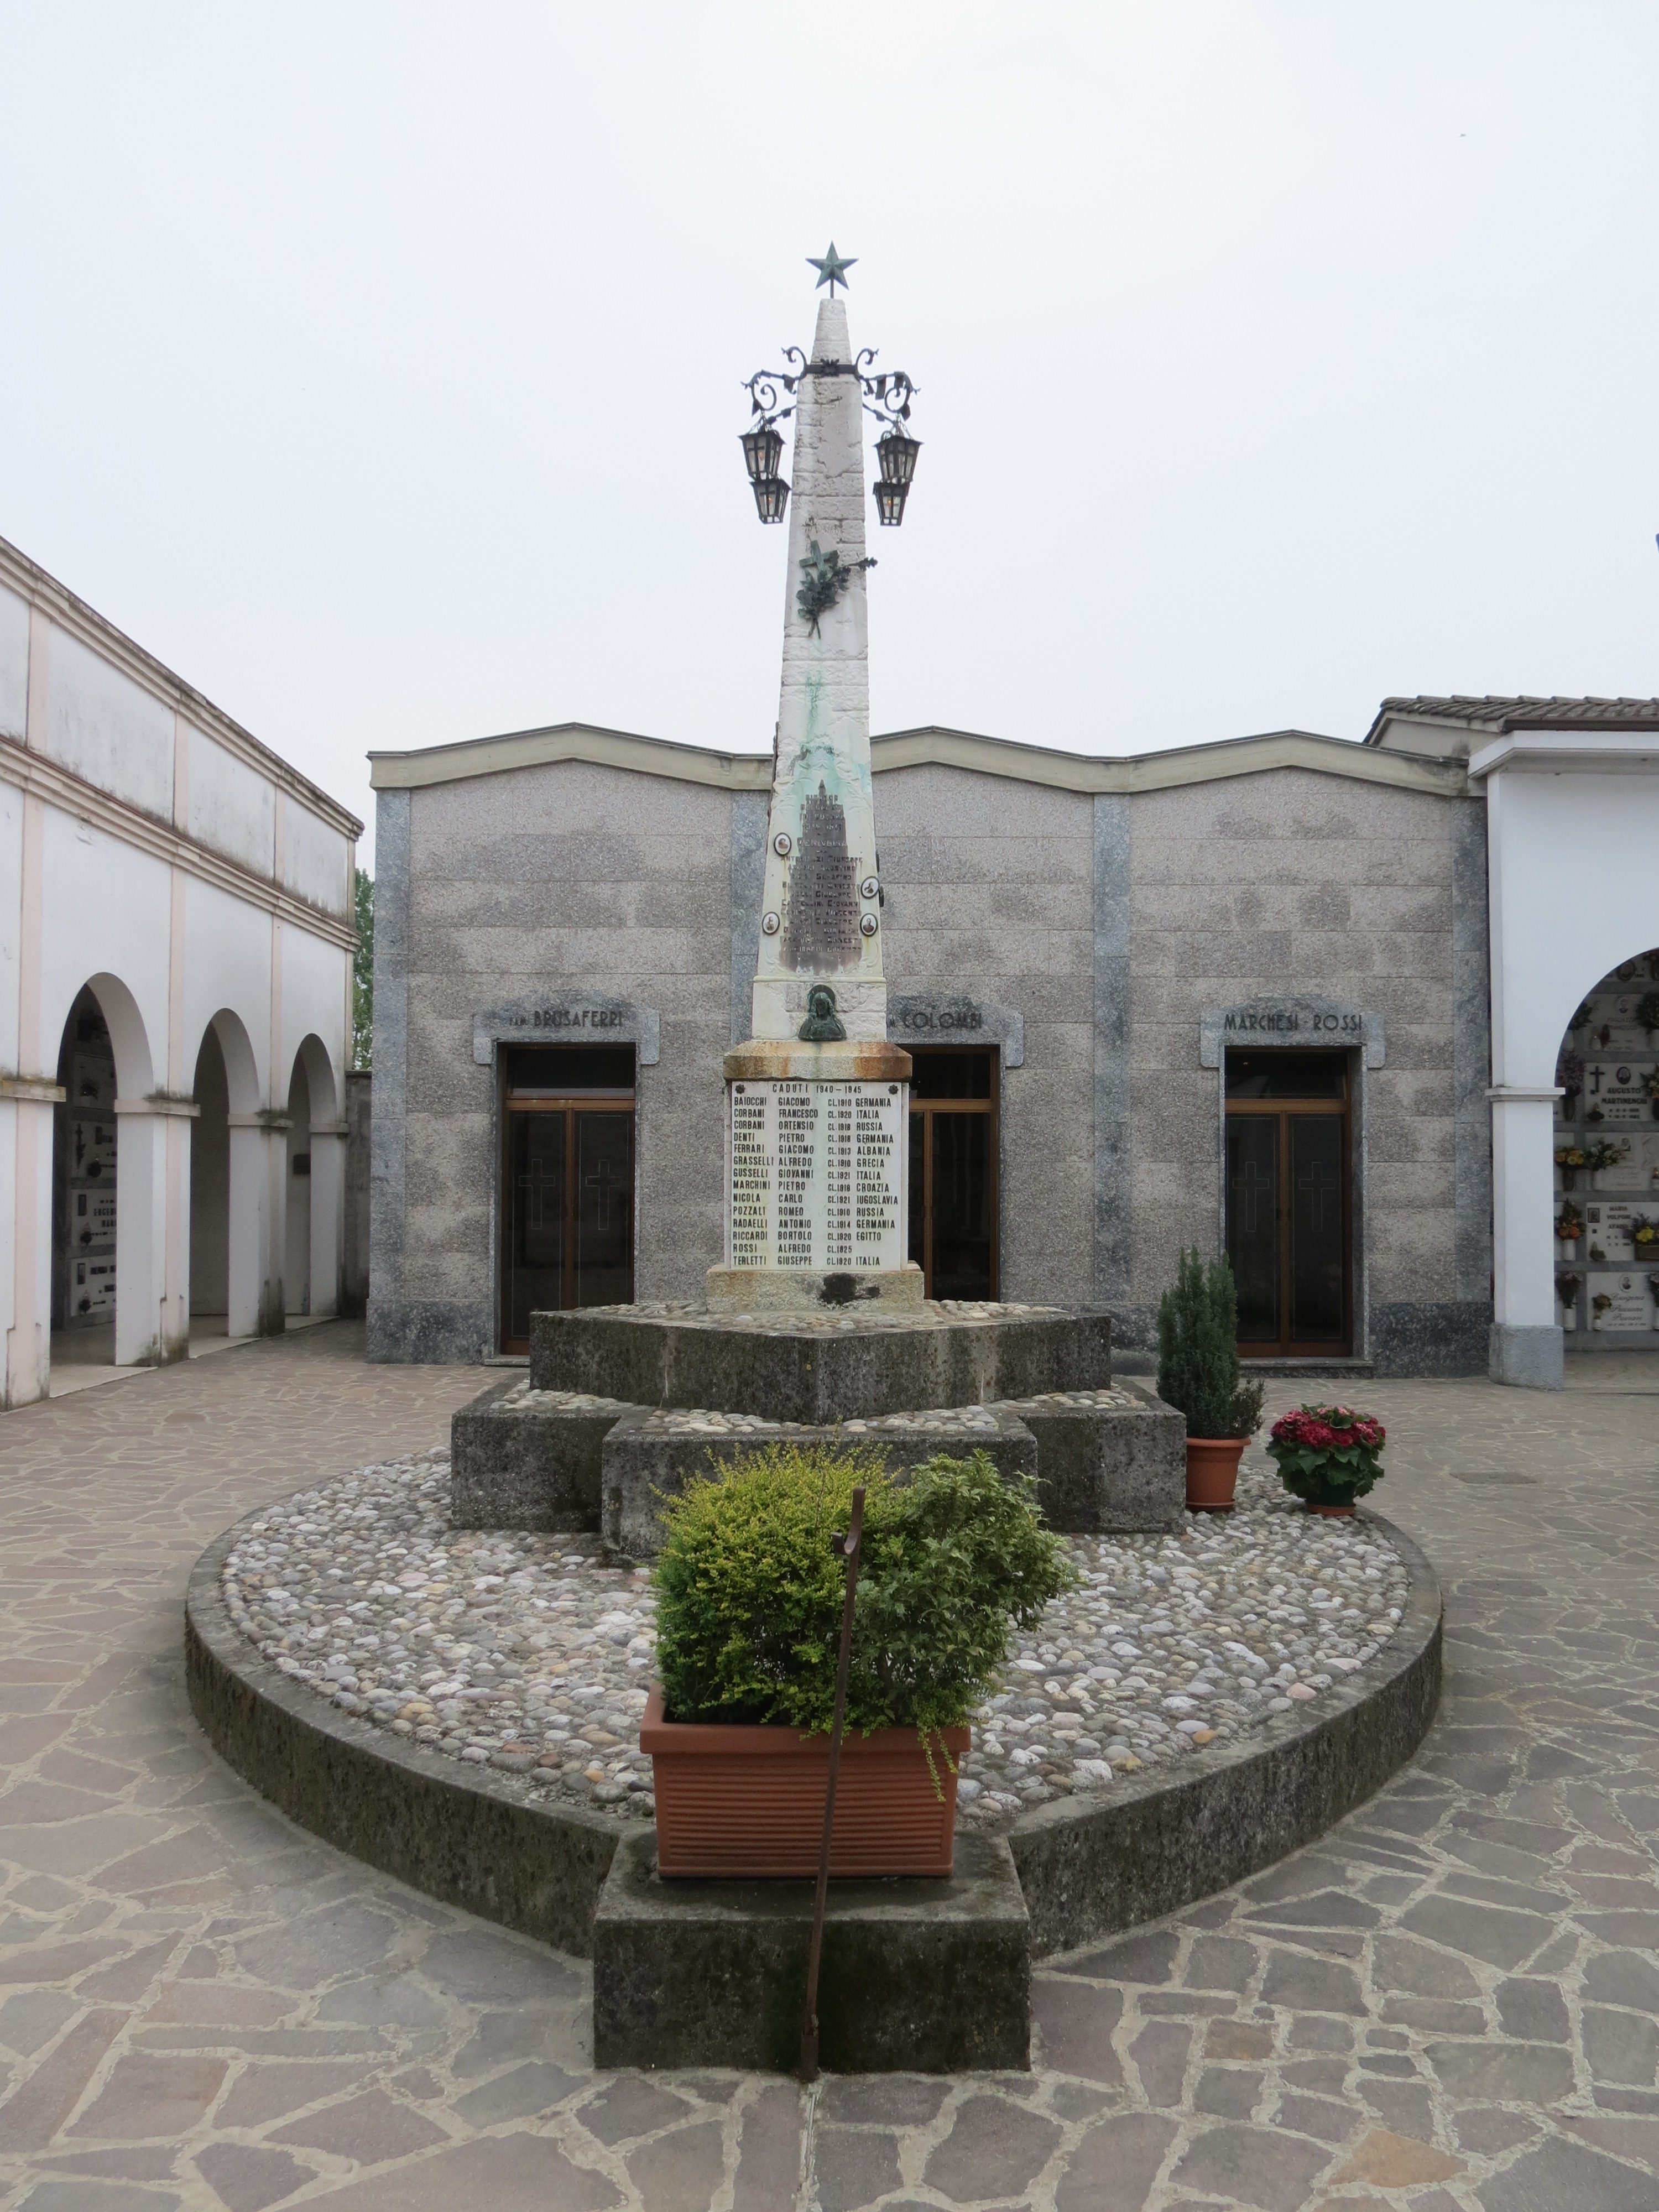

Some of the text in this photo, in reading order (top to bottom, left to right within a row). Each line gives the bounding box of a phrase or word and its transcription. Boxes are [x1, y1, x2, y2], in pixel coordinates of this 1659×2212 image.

[534, 1010, 622, 1026] BRUSAFERRI
[1224, 1014, 1298, 1030] MARCHESI
[1313, 1014, 1362, 1030] ROSSI
[773, 1084, 808, 1093] CADUTI
[734, 1097, 766, 1105] BAIOCCHI
[778, 1097, 810, 1106] GIACOMO
[855, 1098, 891, 1107] GERMANIA
[734, 1109, 764, 1118] CORBANI
[779, 1109, 818, 1118] FRANCESCO
[857, 1110, 879, 1119] ITALIA
[734, 1120, 764, 1130] CORBANI
[779, 1121, 813, 1130] ORTENSIO
[857, 1122, 883, 1131] RUSSIA
[734, 1133, 754, 1141] DENTI
[779, 1133, 805, 1142] PIETRO
[857, 1134, 894, 1143] GERMANIA
[734, 1144, 764, 1153] FERRARI
[779, 1145, 814, 1154] GIACOMO
[857, 1146, 890, 1155] ALBANIA
[734, 1156, 773, 1166] GRASSELLI
[779, 1157, 812, 1166] ALFREDO
[857, 1158, 884, 1167] GRECIA
[733, 1168, 768, 1177] GUSSELLI
[779, 1169, 813, 1178] GIOVANNI
[857, 1171, 880, 1180] ITALIA
[733, 1180, 770, 1190] MARCHINI
[779, 1181, 805, 1190] PIETRO
[857, 1183, 889, 1192] CROAZIA
[733, 1193, 760, 1203] NICOLA
[779, 1194, 802, 1203] CARLO
[857, 1195, 898, 1204] IUGOSLAVIA
[733, 1206, 765, 1215] POZZALI
[779, 1207, 803, 1215] ROMEO
[857, 1207, 884, 1217] RUSSIA
[733, 1219, 767, 1228] RADAELLI
[779, 1219, 811, 1228] ANTONIO
[857, 1219, 895, 1229] GERMANIA
[733, 1231, 767, 1240] RICCARDI
[778, 1231, 812, 1240] BORTOLO
[857, 1232, 881, 1241] EGITTO
[733, 1244, 757, 1253] ROSSI
[778, 1244, 811, 1253] ALFREDO
[733, 1256, 766, 1265] TERLETTI
[778, 1256, 812, 1265] GIUSEPPE
[856, 1256, 880, 1266] ITALIA
